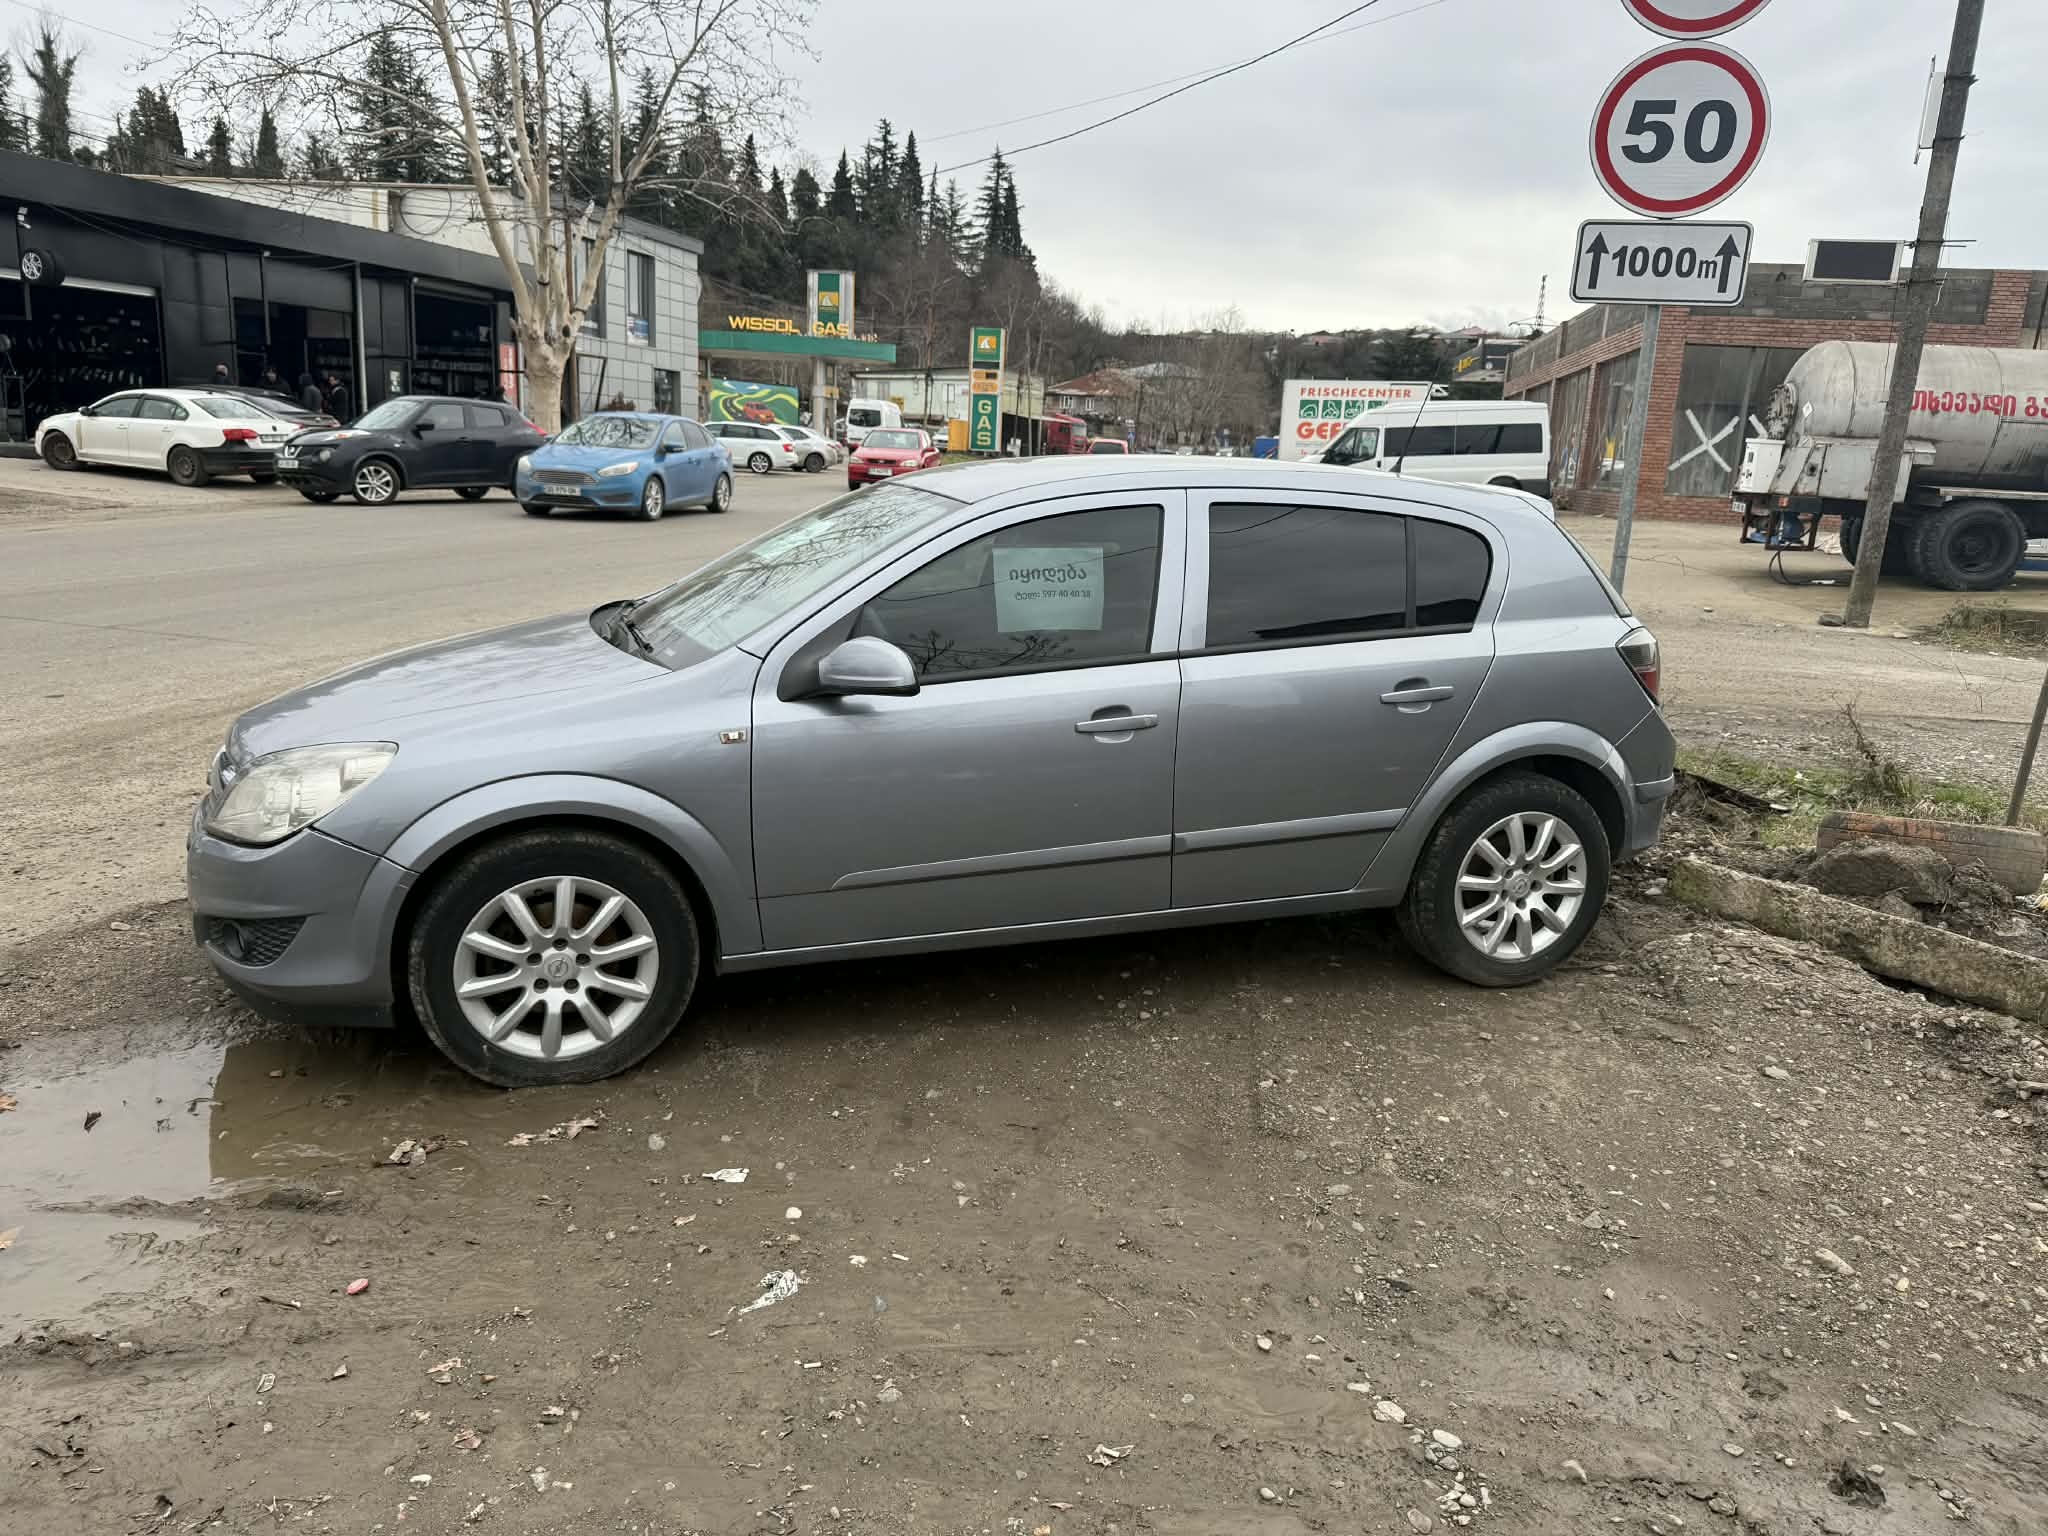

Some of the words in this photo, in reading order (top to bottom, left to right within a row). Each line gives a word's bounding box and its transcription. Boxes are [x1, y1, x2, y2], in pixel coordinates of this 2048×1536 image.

[1621, 100, 1737, 163] 50
[728, 315, 801, 335] WISSOL
[812, 320, 849, 336] GAS
[1300, 387, 1412, 398] FRISCHECENTER
[976, 399, 992, 446] GAS
[1009, 563, 1087, 583] იყიდება
